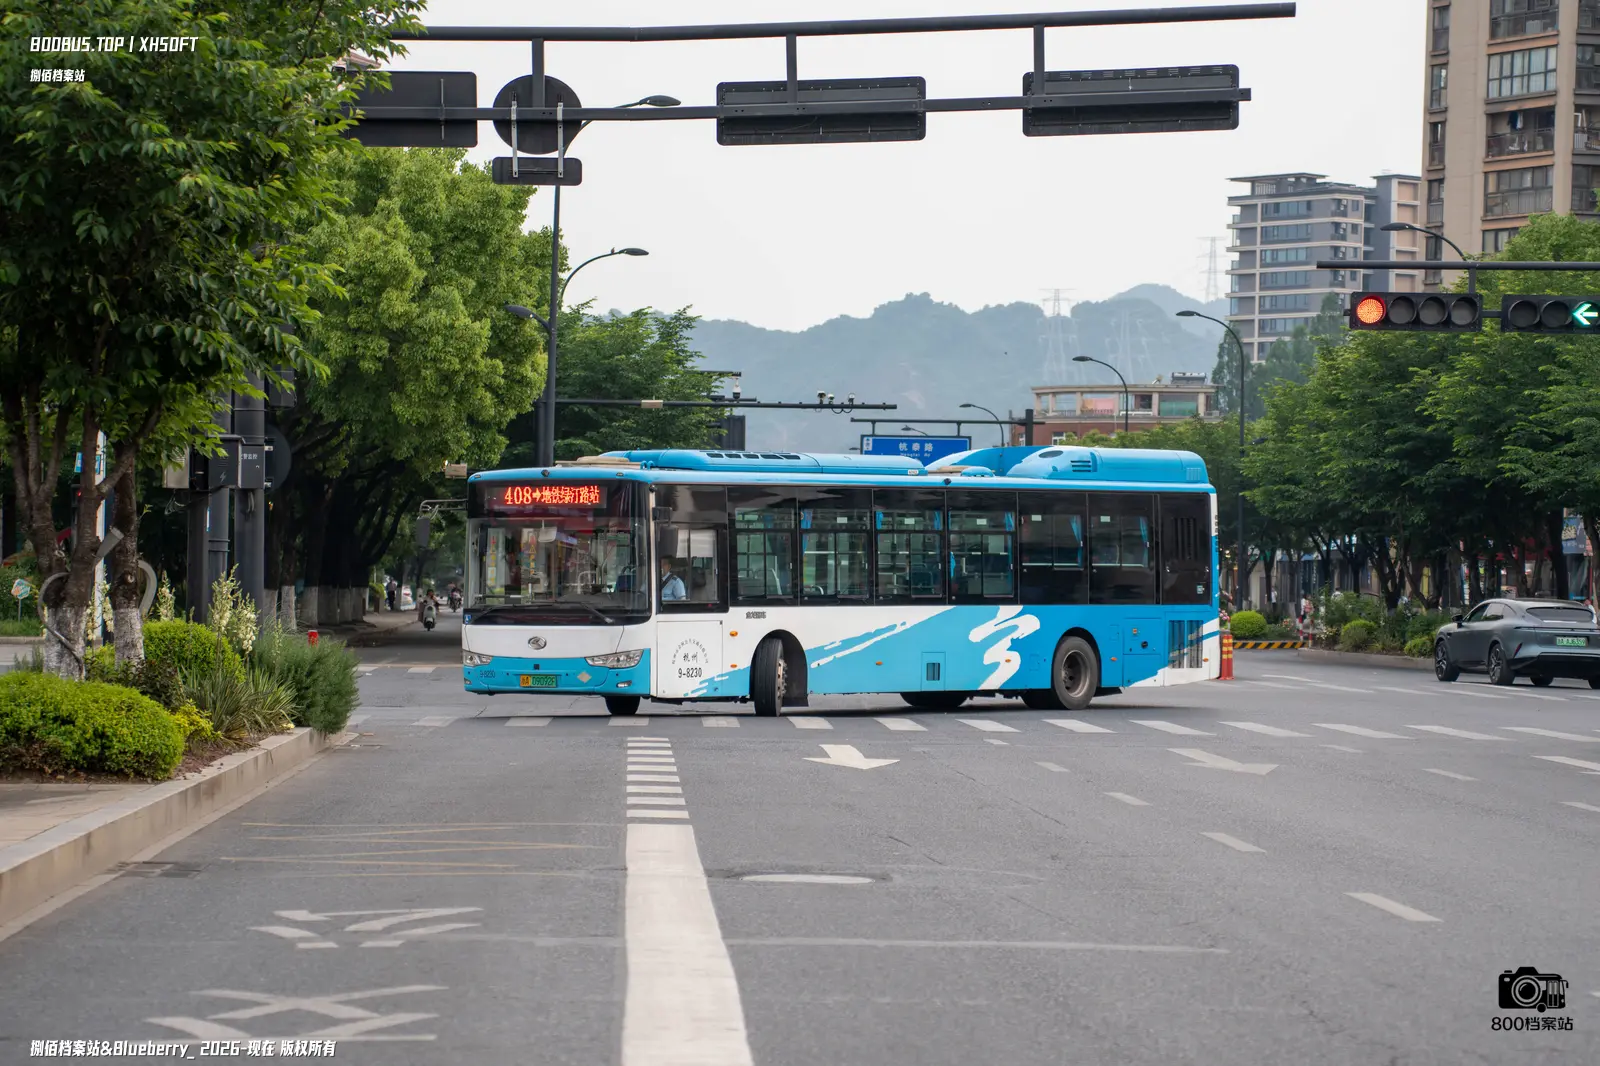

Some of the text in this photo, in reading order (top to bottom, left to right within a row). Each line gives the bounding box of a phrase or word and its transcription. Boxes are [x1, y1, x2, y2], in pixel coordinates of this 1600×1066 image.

[504, 485, 600, 505] 408 地铁绿汀路站
[677, 667, 703, 678] 9-8230
